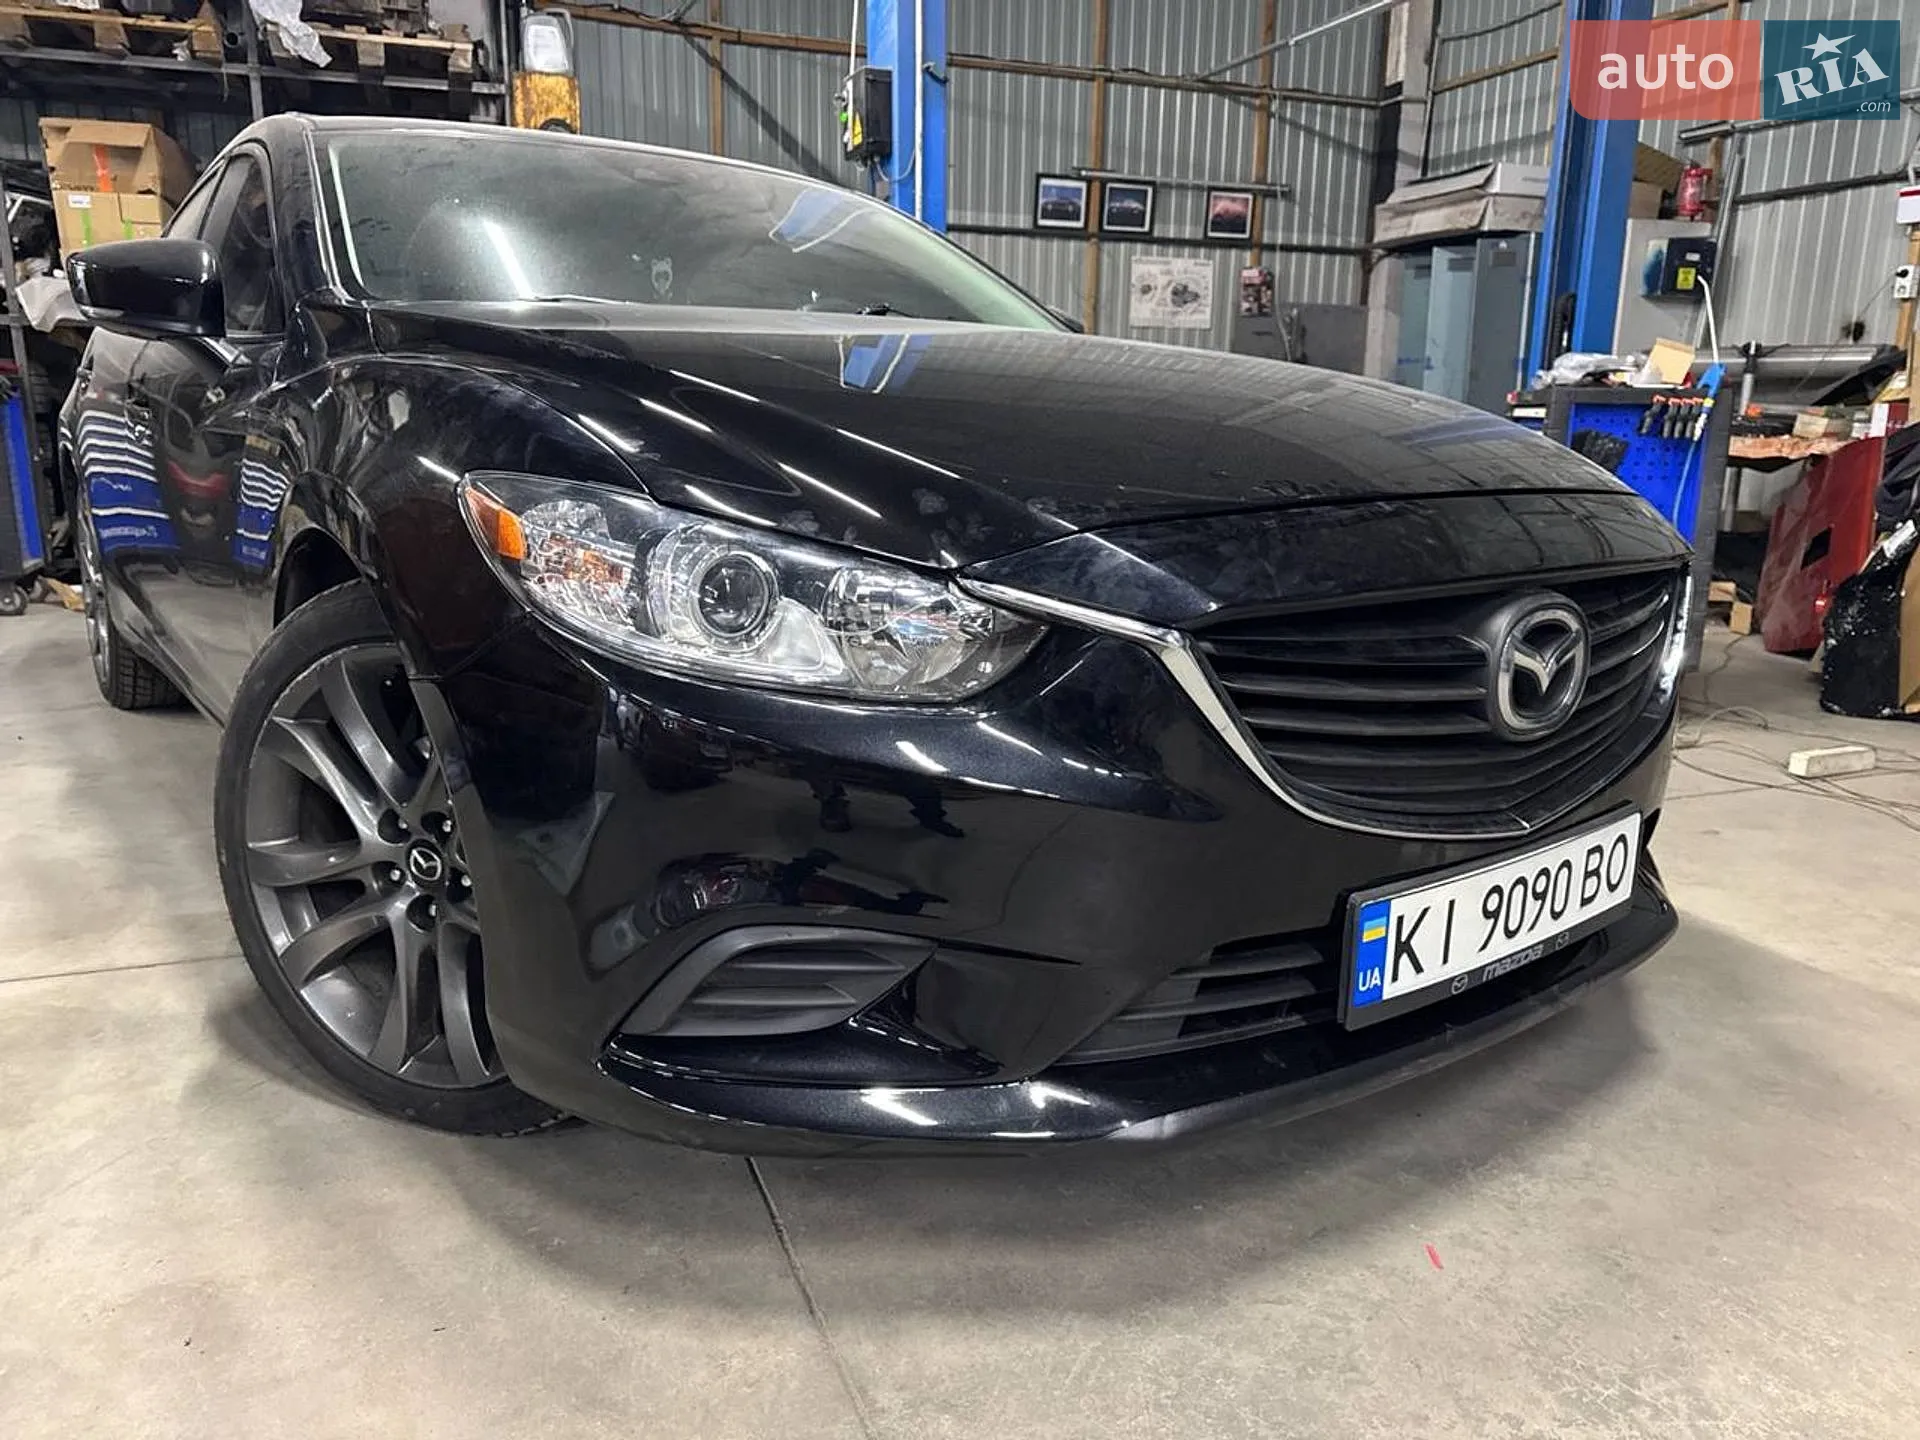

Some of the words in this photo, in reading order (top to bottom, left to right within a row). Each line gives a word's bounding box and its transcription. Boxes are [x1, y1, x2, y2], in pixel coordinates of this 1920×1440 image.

[1391, 900, 1456, 984] KI
[1477, 859, 1571, 952] 9090
[1580, 833, 1628, 909] BO
[1358, 966, 1382, 992] UA
[1482, 944, 1544, 982] mazda
